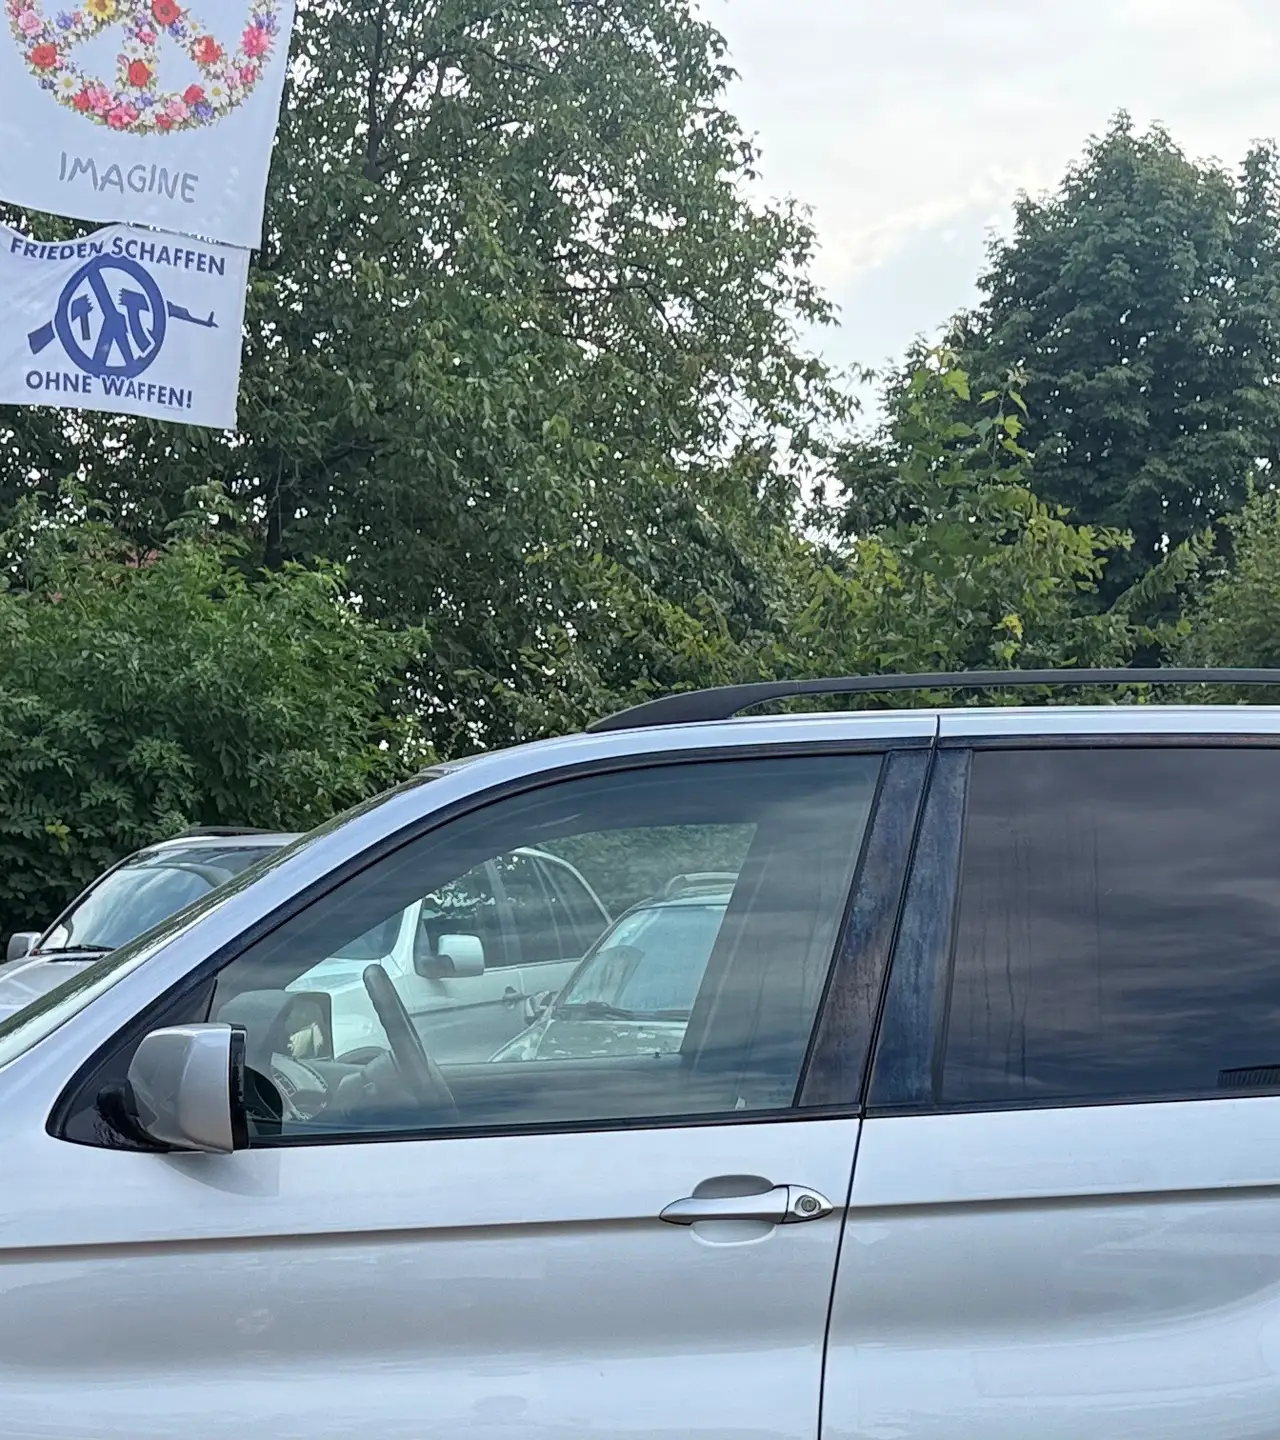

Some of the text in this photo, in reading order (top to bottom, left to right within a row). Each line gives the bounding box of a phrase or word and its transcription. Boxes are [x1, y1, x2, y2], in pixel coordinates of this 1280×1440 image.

[59, 151, 199, 203] IMAGINE
[10, 236, 225, 276] FRIEDEN SCHAFFEN
[26, 370, 193, 409] OHNE WAFFEN!
